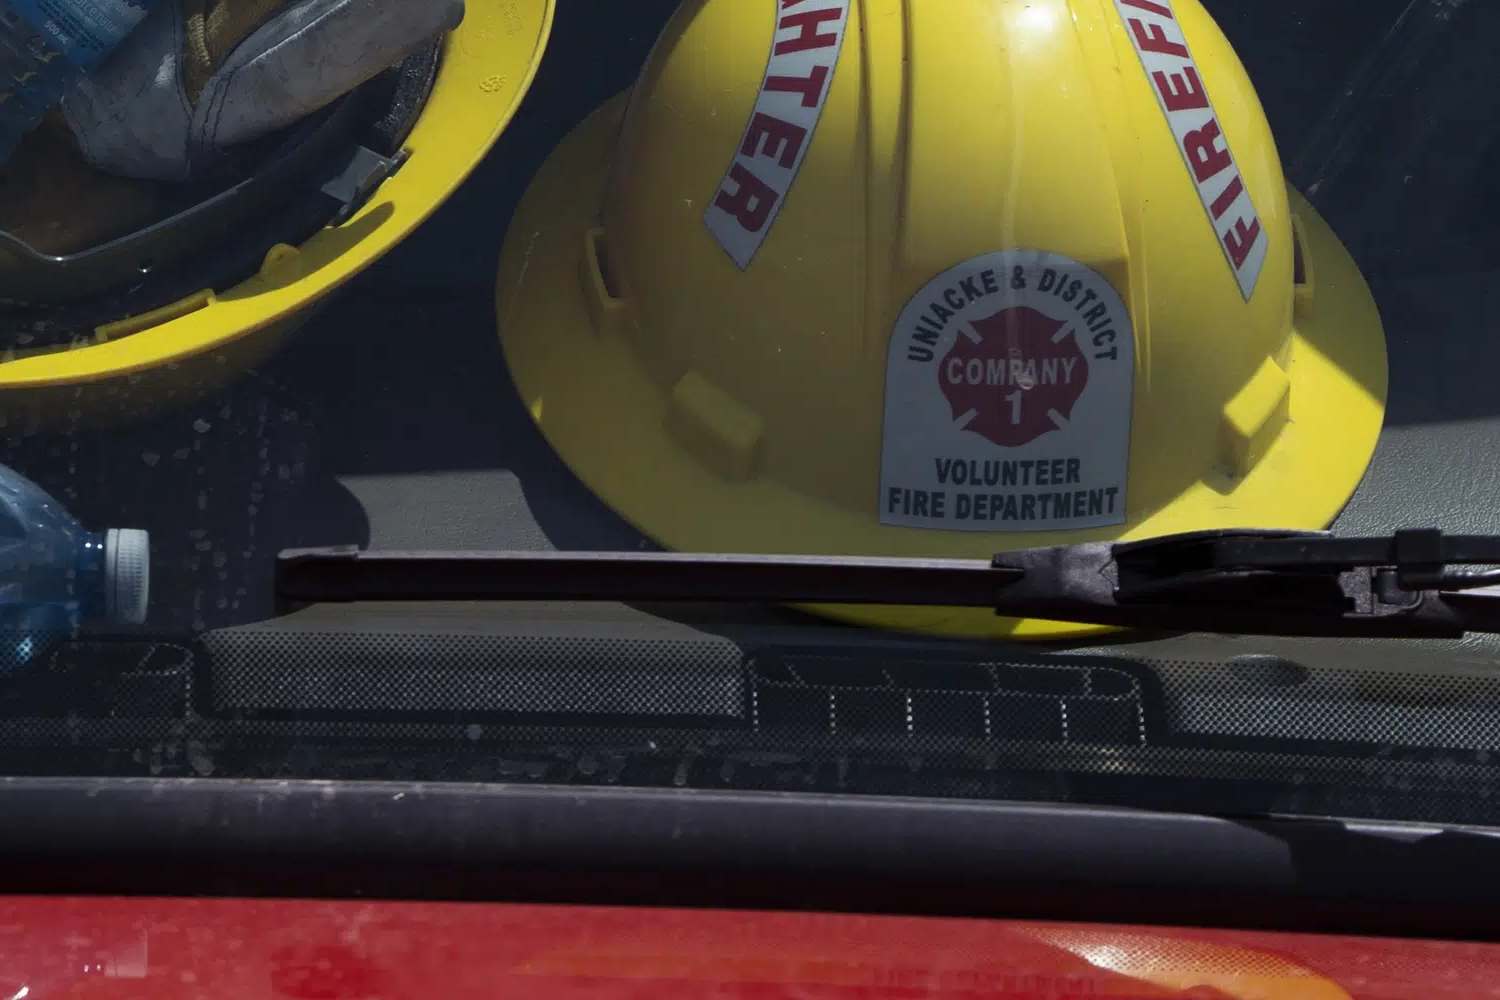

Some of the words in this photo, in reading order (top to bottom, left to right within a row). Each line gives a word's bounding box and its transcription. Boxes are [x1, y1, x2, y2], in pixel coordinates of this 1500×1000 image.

[43, 19, 60, 36] 500
[908, 268, 998, 363] UNIACKE
[1010, 265, 1026, 289] &
[1037, 265, 1119, 362] DISTRICT
[946, 355, 1077, 387] COMPANY
[1005, 392, 1023, 425] 1
[935, 458, 1081, 486] VOLUNTEER
[888, 490, 944, 517] FIRE
[954, 487, 1120, 520] DEPARTMENT
